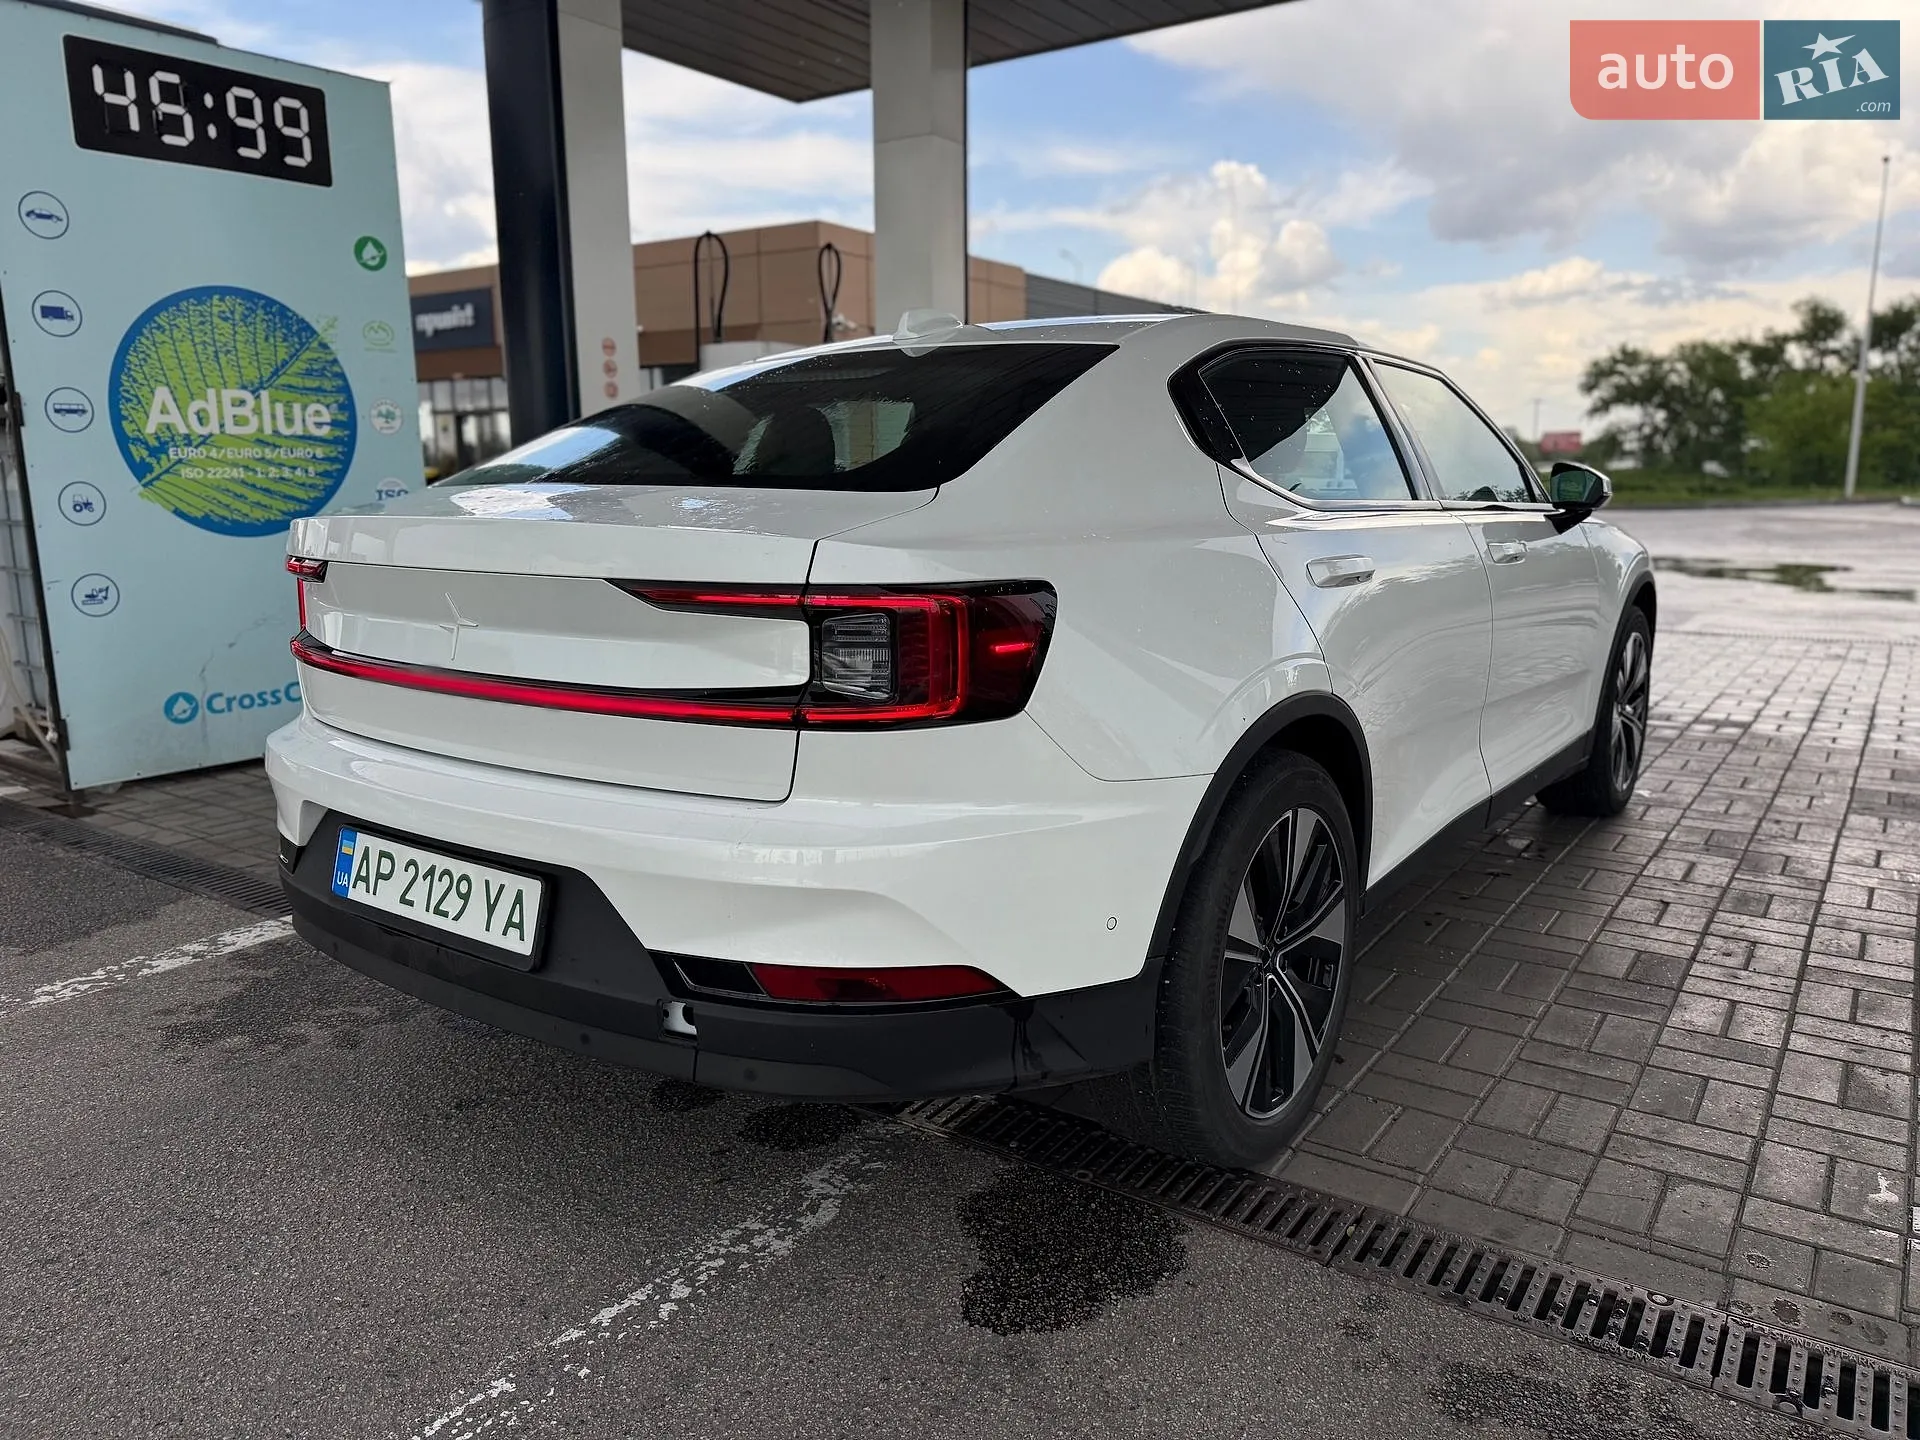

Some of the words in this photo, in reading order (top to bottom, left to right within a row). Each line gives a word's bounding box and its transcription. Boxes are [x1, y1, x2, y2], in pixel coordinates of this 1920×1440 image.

[146, 386, 331, 436] AdBlue
[169, 447, 207, 459] EURO
[181, 467, 203, 479] ISO
[207, 467, 245, 479] 22241
[337, 871, 348, 886] UA
[352, 845, 395, 895] AP
[400, 858, 472, 921] 2129
[485, 879, 525, 942] YA
